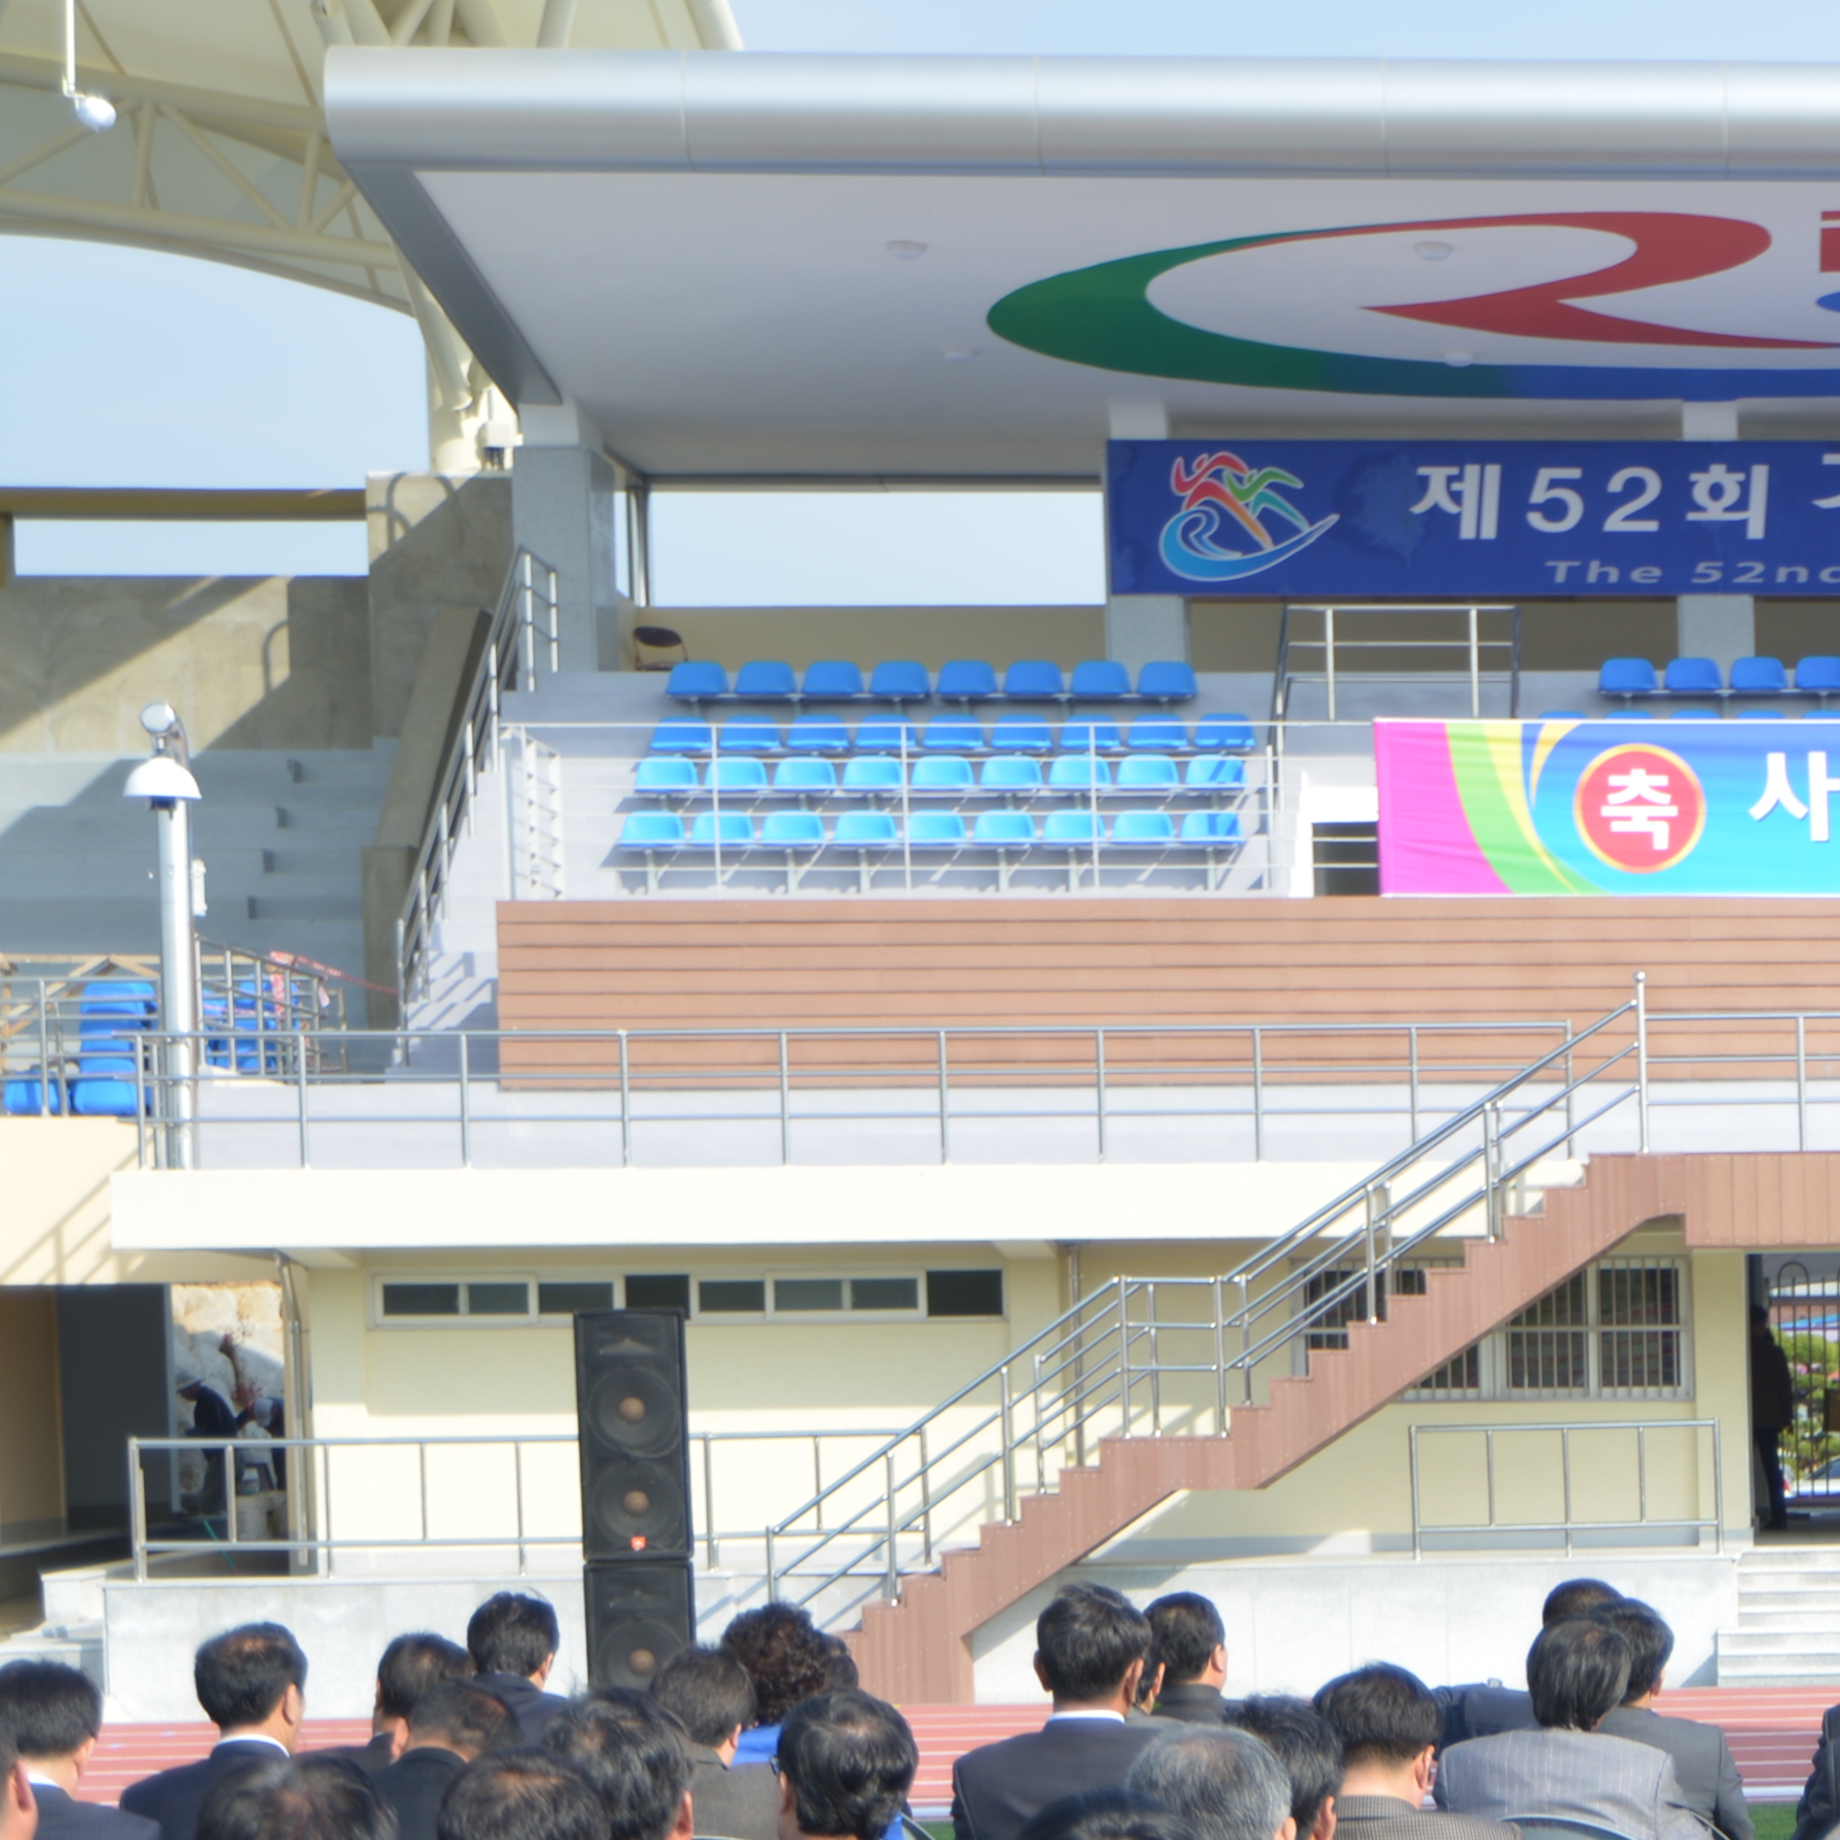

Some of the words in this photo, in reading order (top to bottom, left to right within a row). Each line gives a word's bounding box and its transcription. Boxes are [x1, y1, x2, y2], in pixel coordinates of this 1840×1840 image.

[1409, 462, 1768, 541] 제52회
[1545, 560, 1662, 584] The
[1601, 768, 1679, 851] 축
